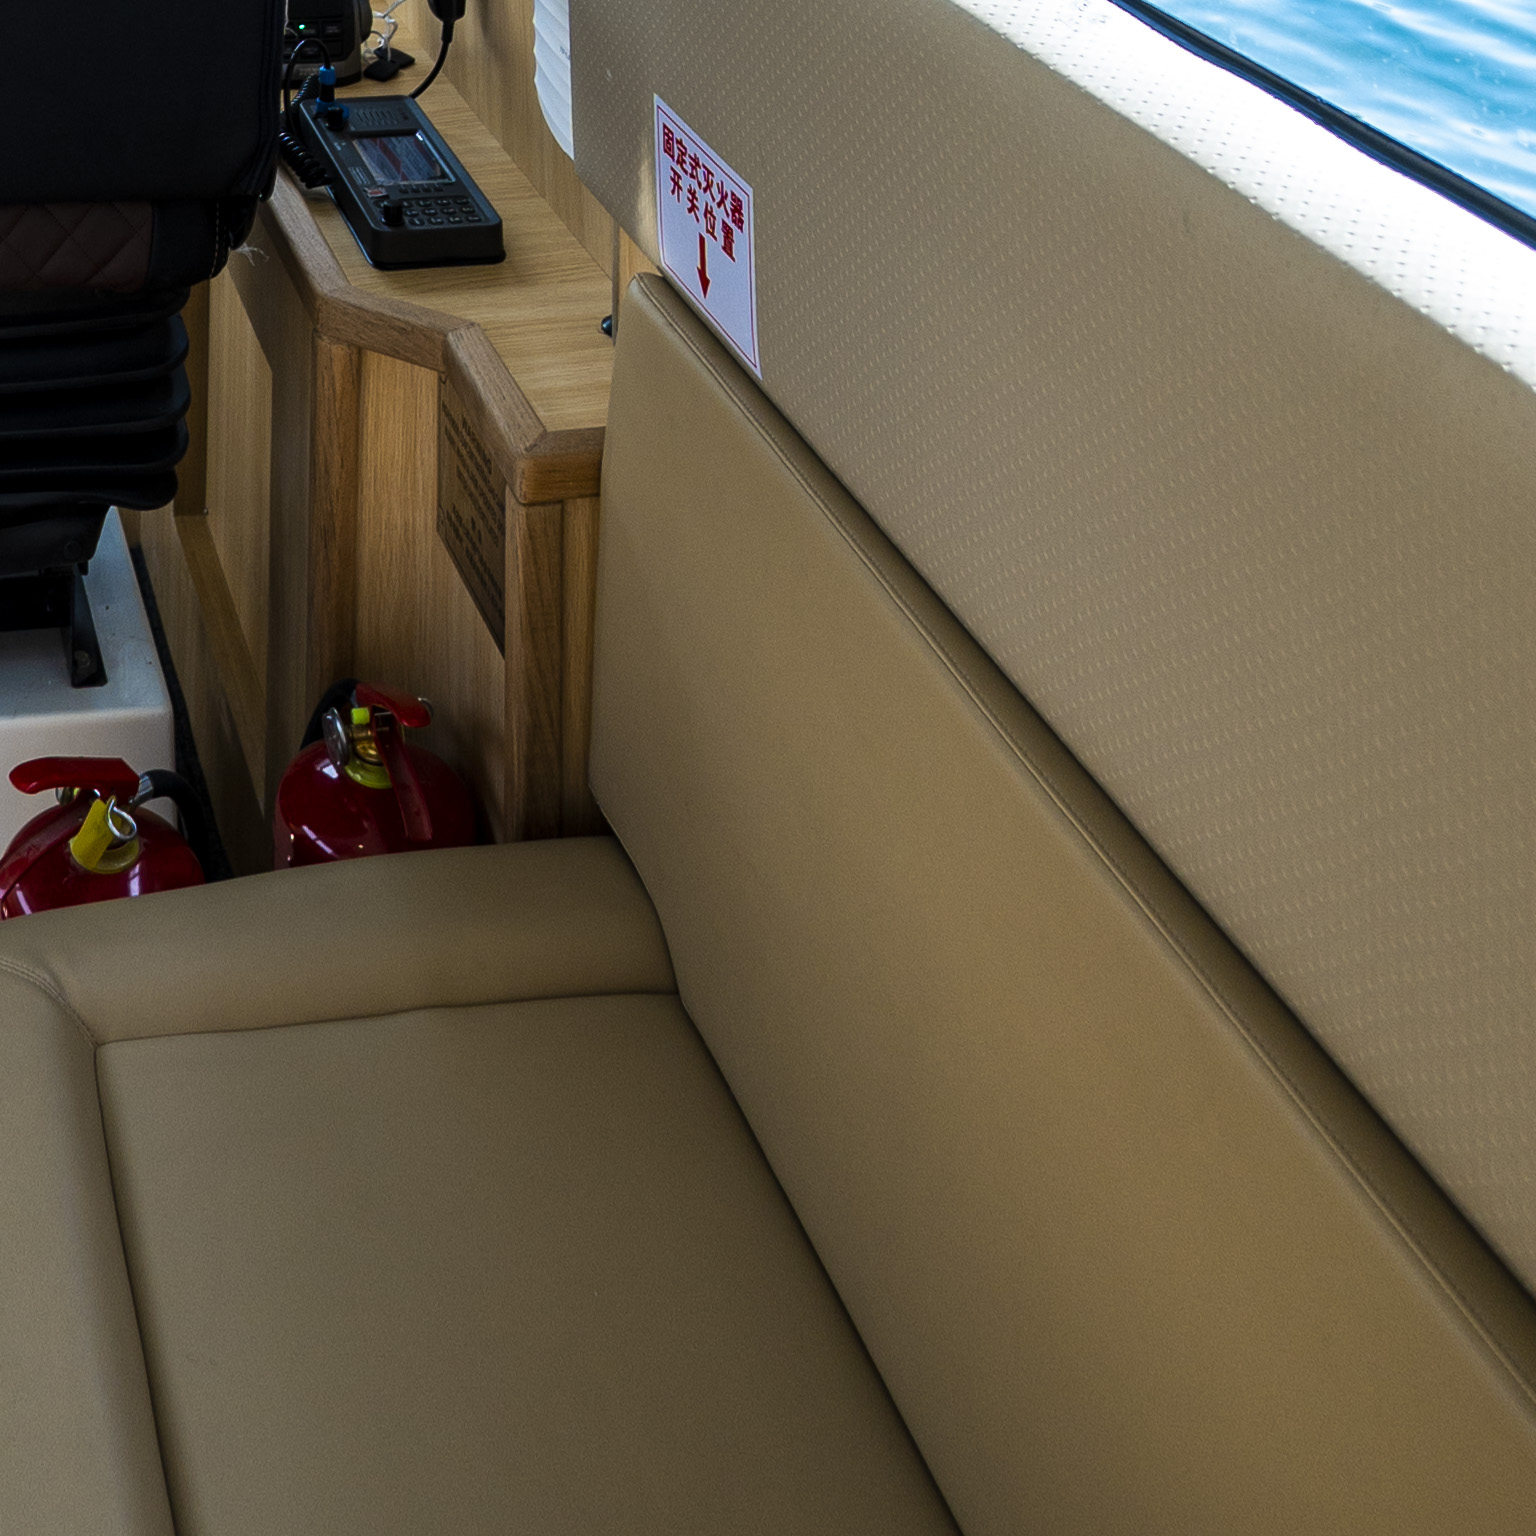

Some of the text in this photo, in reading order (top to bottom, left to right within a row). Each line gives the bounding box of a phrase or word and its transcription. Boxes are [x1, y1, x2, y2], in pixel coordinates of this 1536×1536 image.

[662, 122, 745, 234] 固定式灭火器
[669, 165, 736, 263] 开关位置
